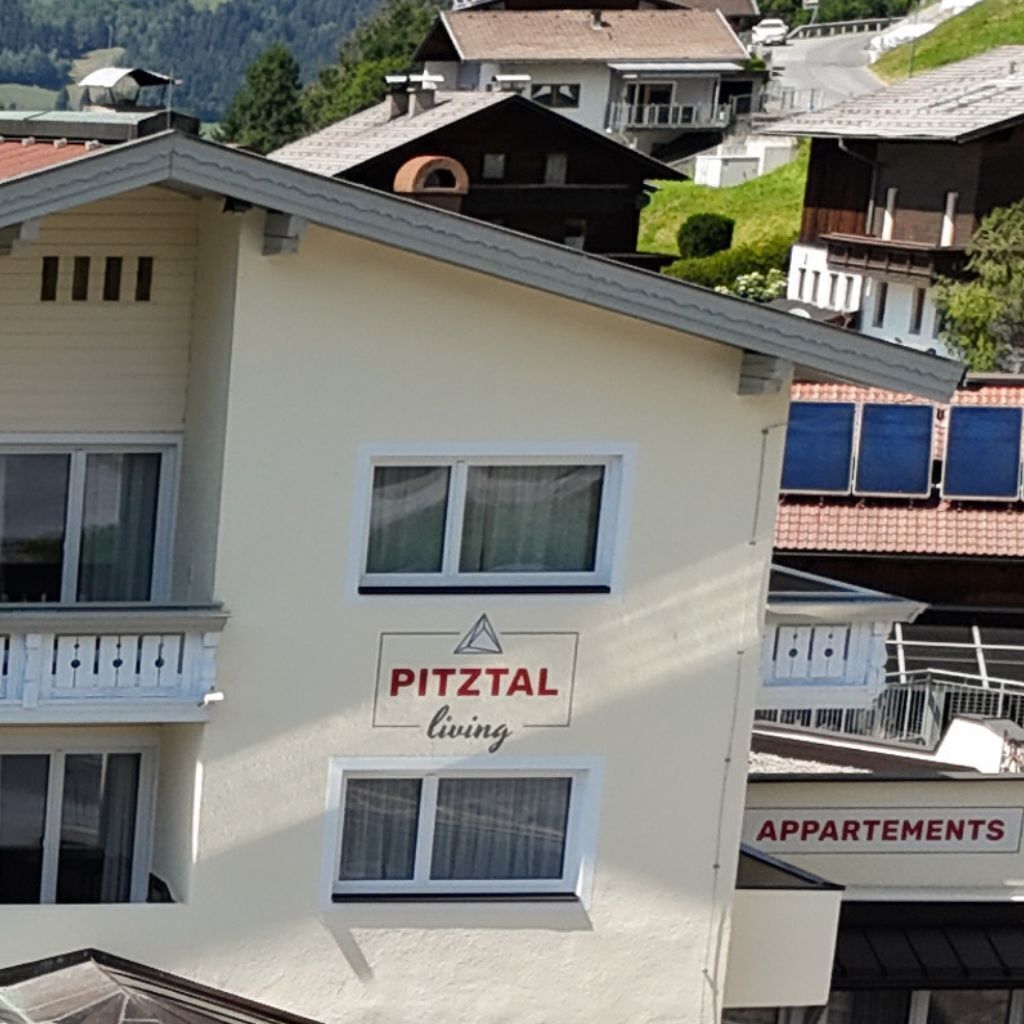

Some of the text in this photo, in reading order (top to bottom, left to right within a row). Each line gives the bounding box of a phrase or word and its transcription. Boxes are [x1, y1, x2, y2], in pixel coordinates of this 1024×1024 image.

[389, 667, 559, 697] PITZTAL
[426, 704, 513, 754] living
[755, 818, 1006, 842] APPARTEMENTS
